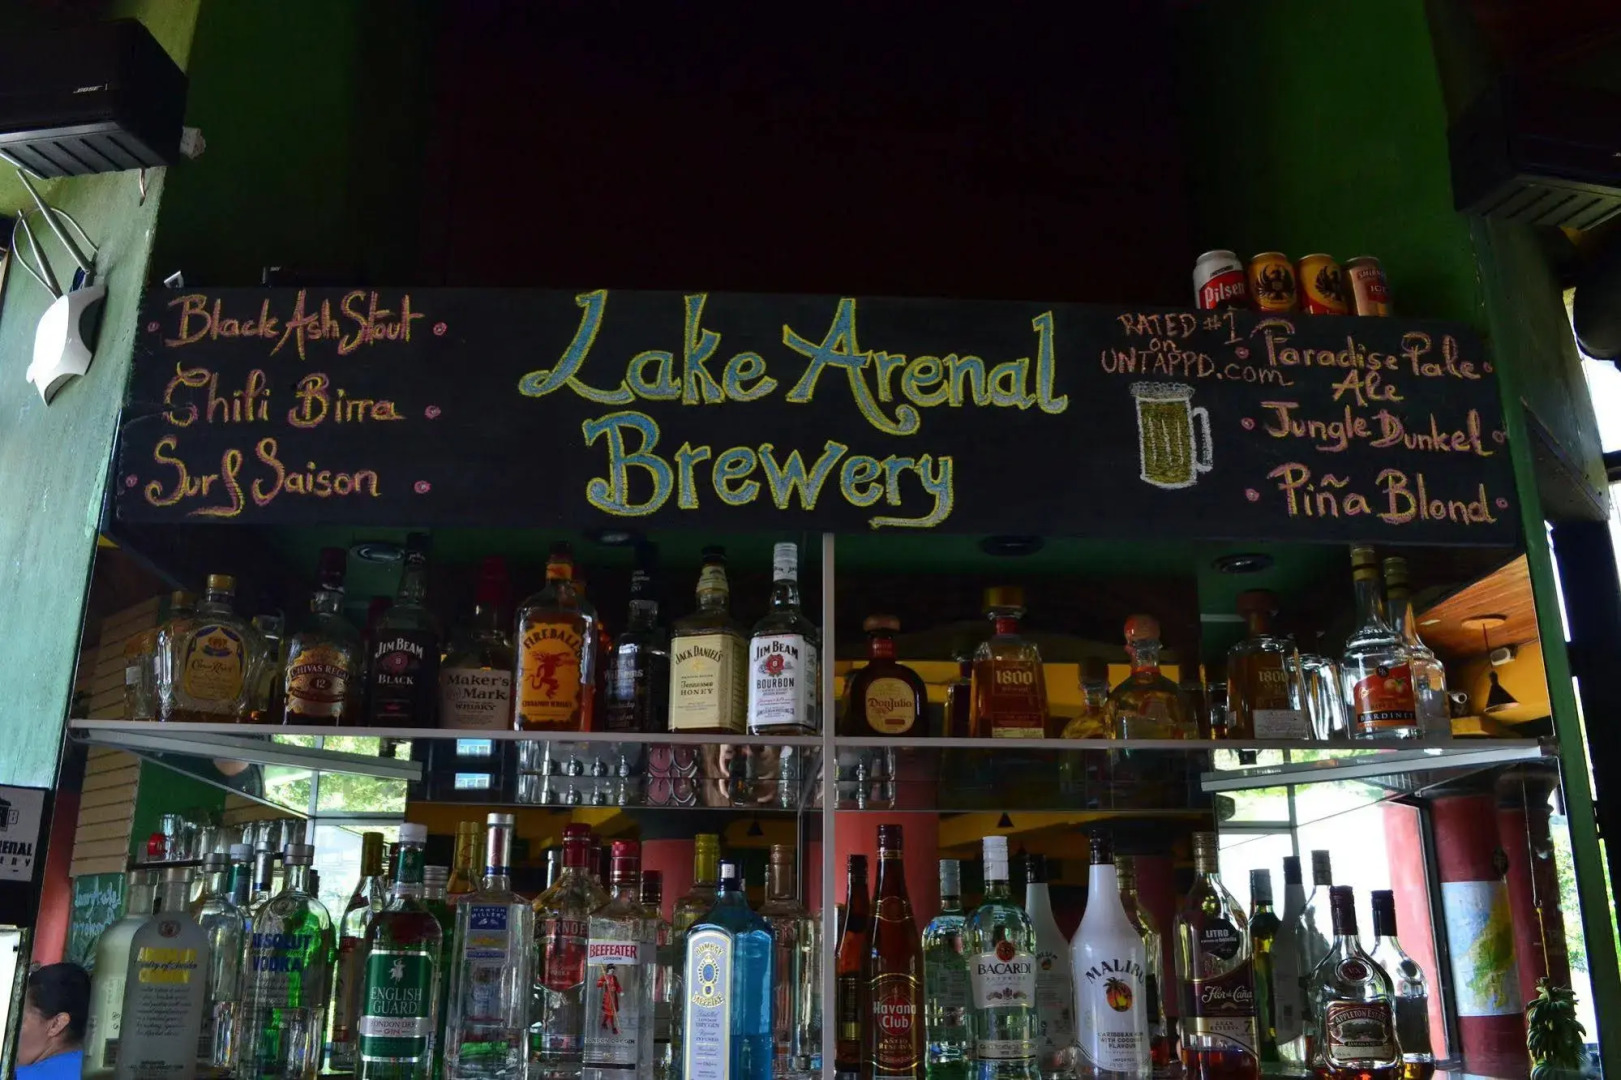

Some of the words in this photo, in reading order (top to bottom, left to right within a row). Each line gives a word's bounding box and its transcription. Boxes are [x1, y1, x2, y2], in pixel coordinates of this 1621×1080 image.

[1204, 282, 1246, 304] Pilsen
[164, 293, 279, 347] Black
[270, 289, 340, 360] Ash
[338, 290, 425, 355] Stout
[1117, 313, 1197, 338] RATED
[1202, 305, 1245, 344] #1
[1150, 338, 1180, 353] on
[1250, 318, 1398, 369] Paradise
[1401, 331, 1481, 379] Pale
[518, 289, 778, 405] Lake
[782, 297, 1069, 435] Arenal
[1101, 348, 1294, 386] UNTAPPD.com
[162, 361, 271, 427] Chili
[287, 372, 406, 428] Birra
[1332, 370, 1403, 407] Ale
[1260, 401, 1372, 452] Jungle
[1370, 409, 1493, 456] Dunkel
[145, 436, 245, 517] Surf
[252, 437, 382, 506] Saison
[583, 411, 954, 529] Brewery
[1267, 462, 1372, 517] Piña
[1376, 468, 1497, 525] Blond
[523, 628, 581, 650] FIREBALL
[375, 641, 394, 659] JIM
[396, 638, 424, 659] BEAM
[754, 645, 771, 661] JIM
[772, 641, 798, 661] BEAM
[675, 649, 694, 665] JACK
[291, 664, 323, 678] CHIVAS
[996, 669, 1033, 685] 1800
[315, 679, 326, 689] 12
[378, 674, 414, 686] BLACK
[447, 674, 509, 686] Maker's
[756, 678, 795, 689] BOURBON
[463, 688, 508, 701] Mark
[680, 688, 714, 696] HONEY
[1205, 929, 1230, 938] LITRO
[589, 944, 638, 959] BEEFEATER
[977, 962, 1031, 975] BACARDI
[1086, 959, 1144, 984] MALIBU
[370, 986, 422, 1001] ENGLISH
[1202, 986, 1226, 1003] Flor
[373, 1000, 418, 1014] GUARD
[873, 1001, 917, 1015] Havana
[882, 1015, 909, 1028] Club
